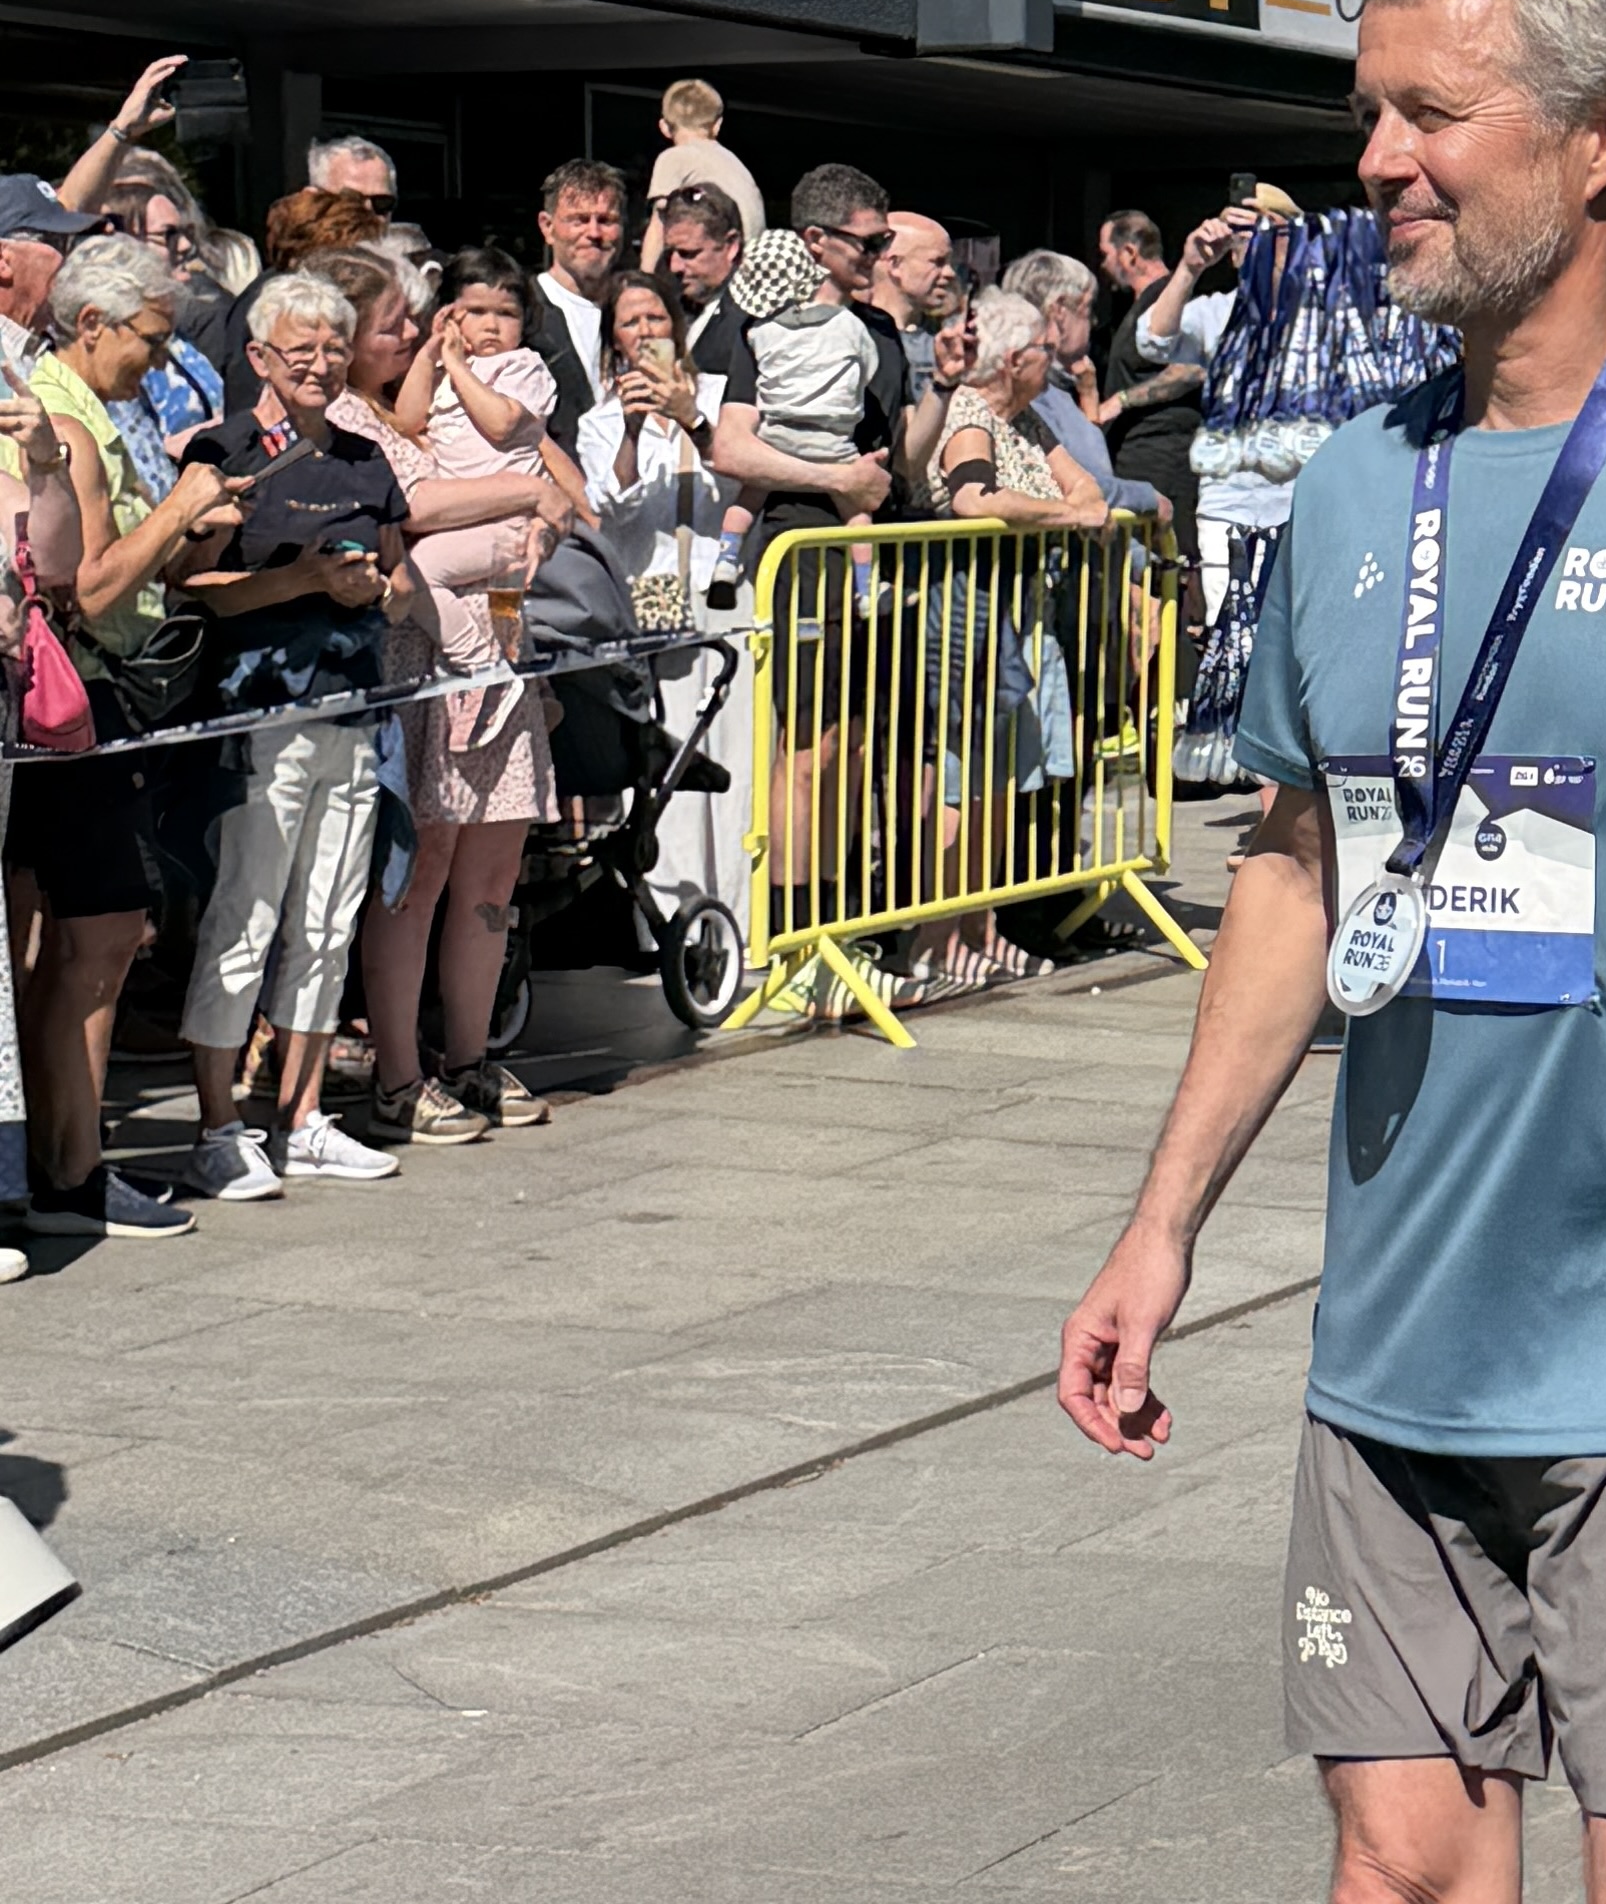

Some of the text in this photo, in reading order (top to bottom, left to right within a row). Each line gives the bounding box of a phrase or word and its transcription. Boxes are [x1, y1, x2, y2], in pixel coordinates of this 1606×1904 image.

[1405, 508, 1442, 650] ROYAL
[1395, 657, 1433, 749] RUN
[1343, 787, 1392, 803] ROYAL
[1429, 884, 1520, 915] DERIK
[1349, 929, 1395, 953] ROYAL
[1436, 939, 1446, 974] 1
